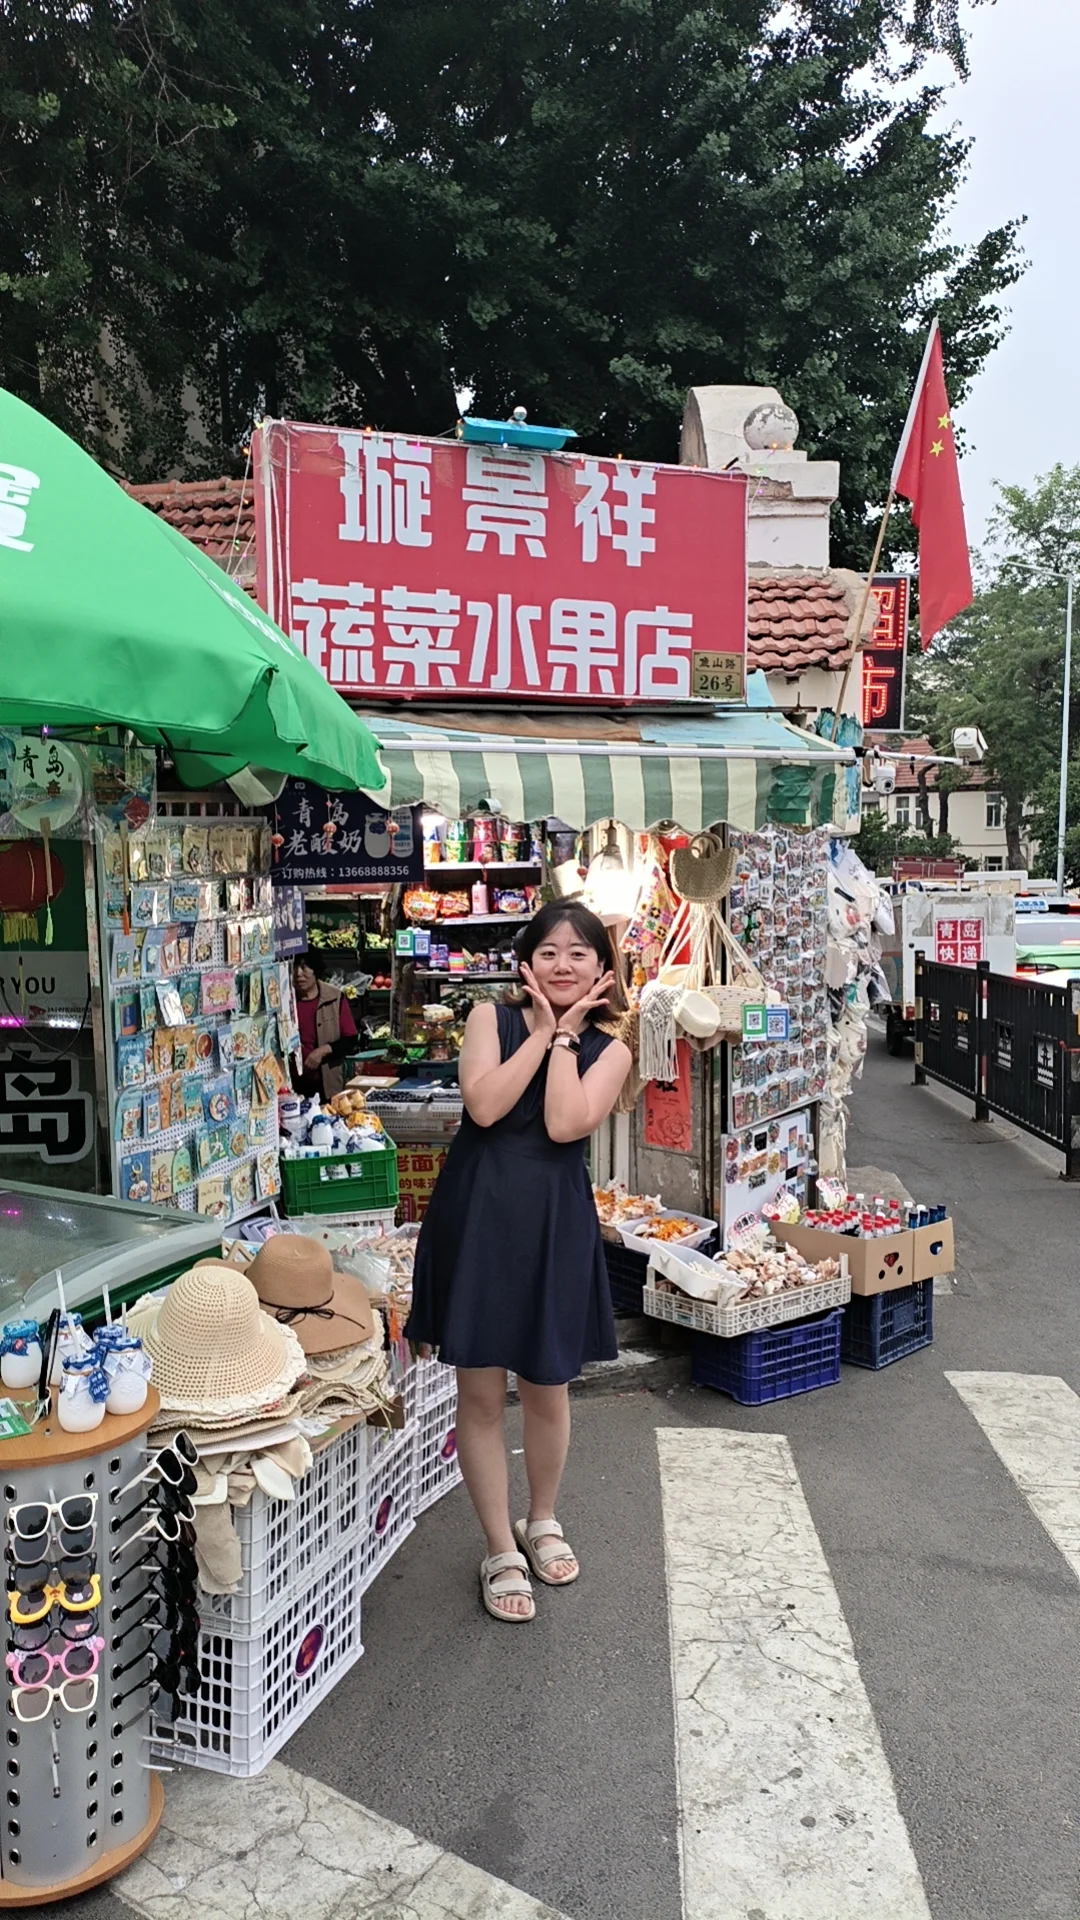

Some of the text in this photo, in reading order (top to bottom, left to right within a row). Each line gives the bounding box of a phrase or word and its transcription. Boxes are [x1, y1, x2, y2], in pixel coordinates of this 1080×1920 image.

[337, 434, 656, 567] 璇景祥
[291, 578, 693, 698] 蔬菜水果店
[699, 656, 736, 669] 鱼山路
[699, 674, 735, 692] 26号
[16, 744, 64, 779] 青岛
[292, 797, 350, 828] 青岛
[283, 828, 362, 859] 老酸奶
[939, 922, 978, 939] 青岛
[939, 945, 979, 961] 快递
[10, 976, 56, 995] YOU
